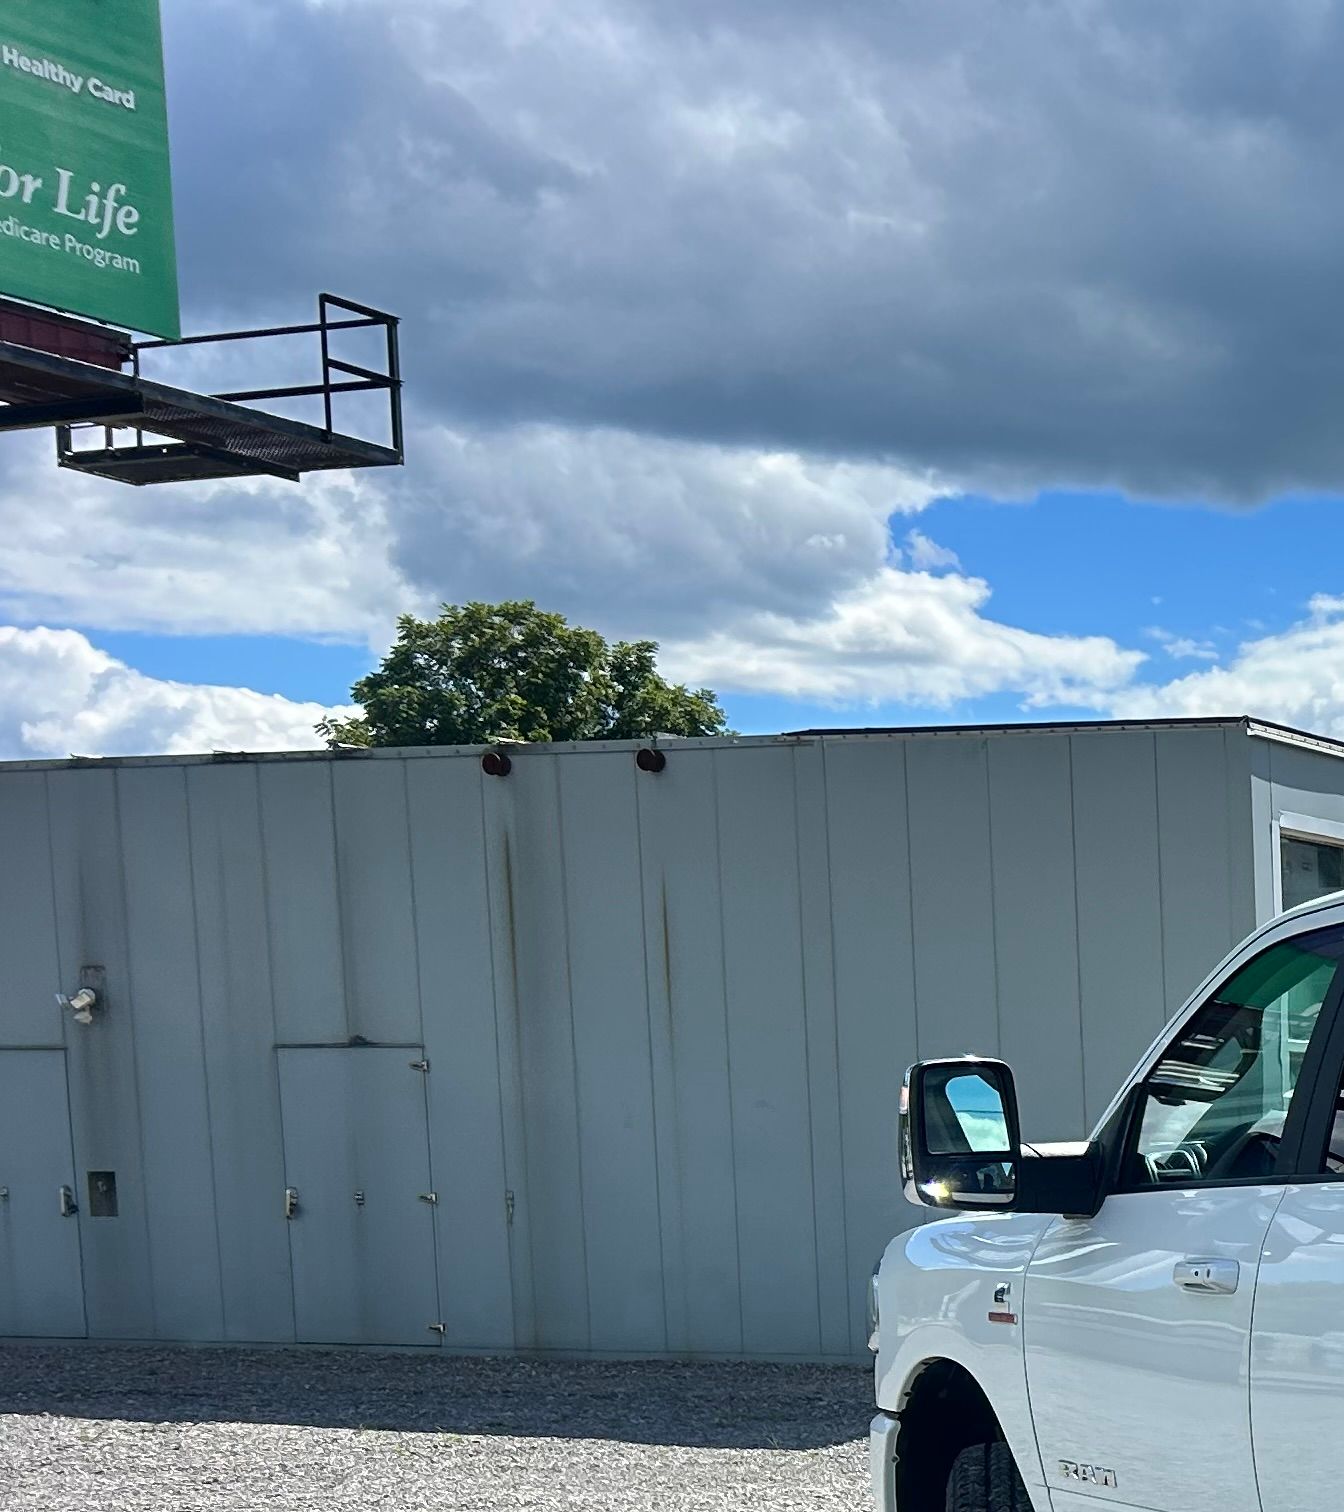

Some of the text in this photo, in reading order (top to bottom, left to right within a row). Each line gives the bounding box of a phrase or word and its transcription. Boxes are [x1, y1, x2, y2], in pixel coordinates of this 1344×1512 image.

[2, 44, 136, 111] Healthy Card
[0, 164, 140, 239] or Life
[0, 215, 140, 274] dicare Program
[1057, 1459, 1118, 1488] RAM
